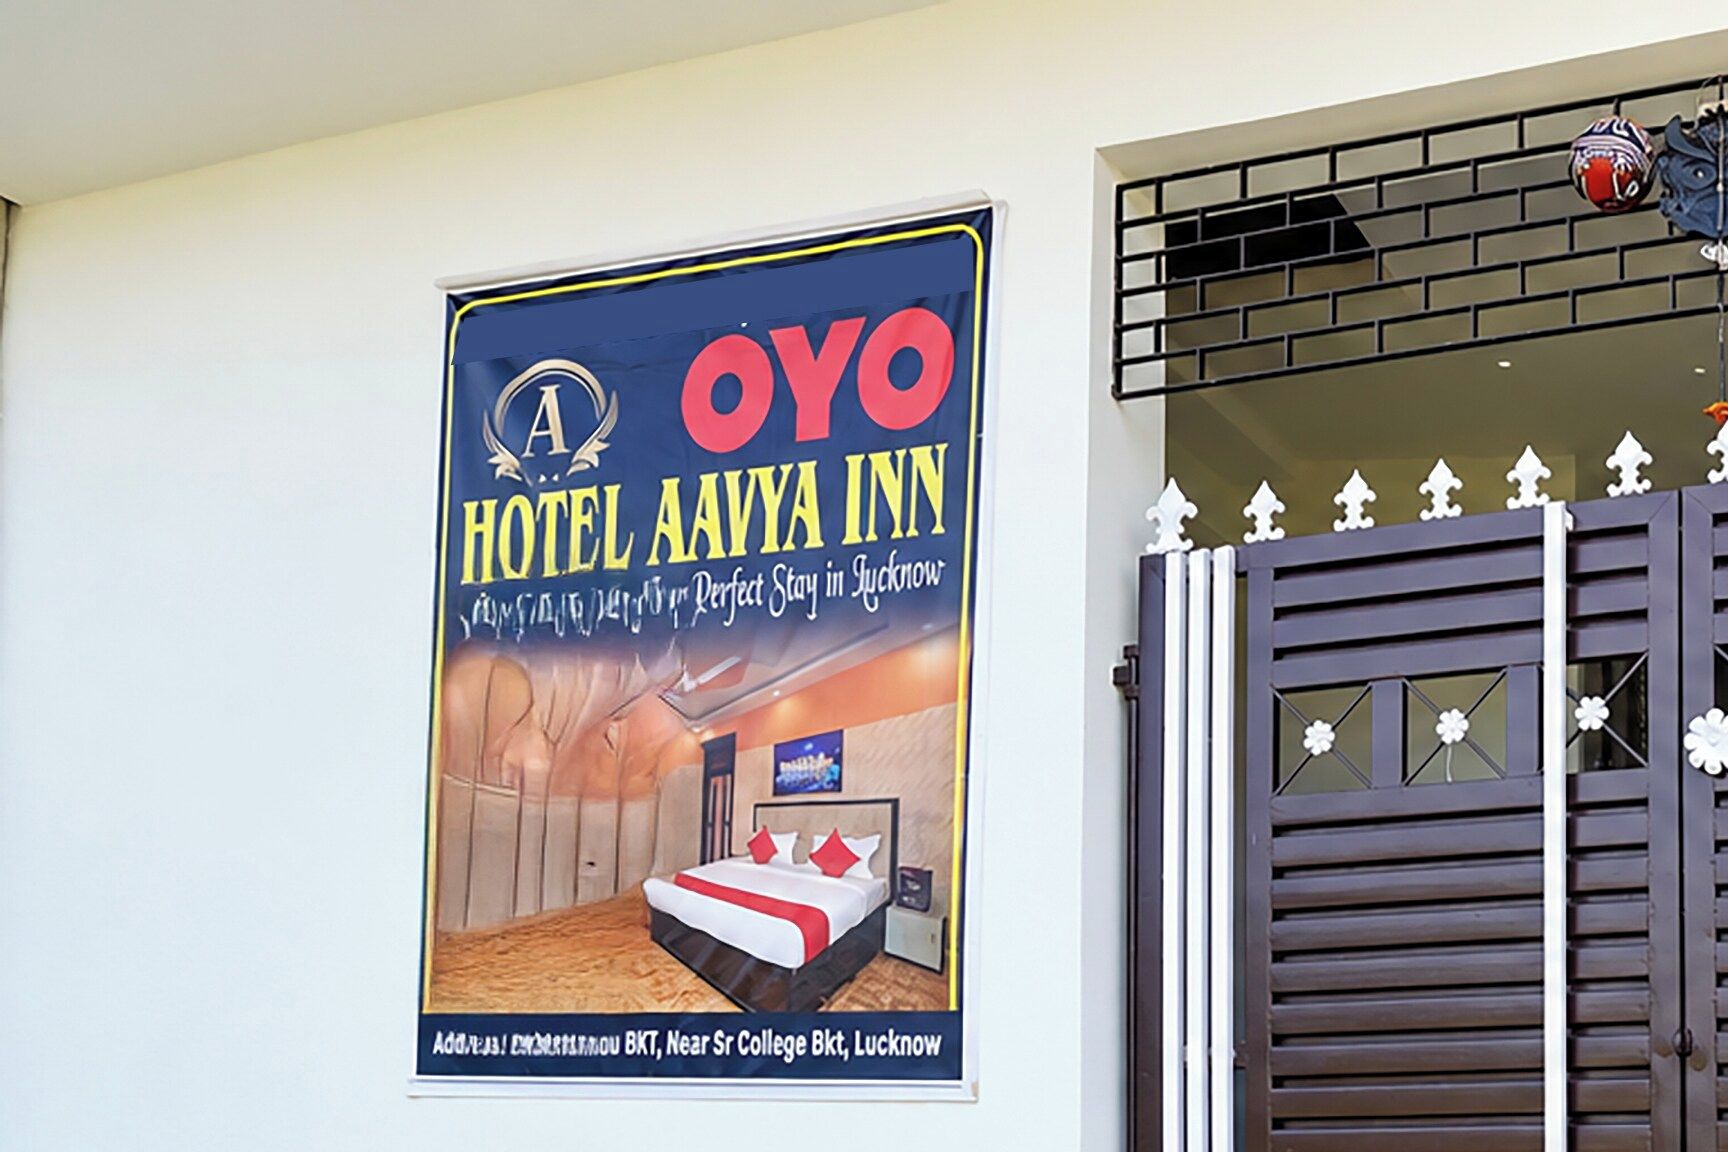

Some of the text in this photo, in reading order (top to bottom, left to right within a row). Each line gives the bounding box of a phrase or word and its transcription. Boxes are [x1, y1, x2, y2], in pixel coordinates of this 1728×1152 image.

[681, 306, 955, 453] OYO
[521, 384, 571, 458] A
[461, 442, 949, 585] HOTEL AAVYA INN
[692, 567, 764, 627] Perfect
[769, 563, 818, 621] Stay
[826, 560, 844, 597] in
[851, 549, 946, 613] Lucknow
[625, 1030, 661, 1060] BKT,
[666, 1029, 709, 1056] Near
[713, 1029, 733, 1056] Sr
[737, 1028, 806, 1062] College
[811, 1028, 849, 1061] Bkt,
[854, 1028, 942, 1056] Lucknow
